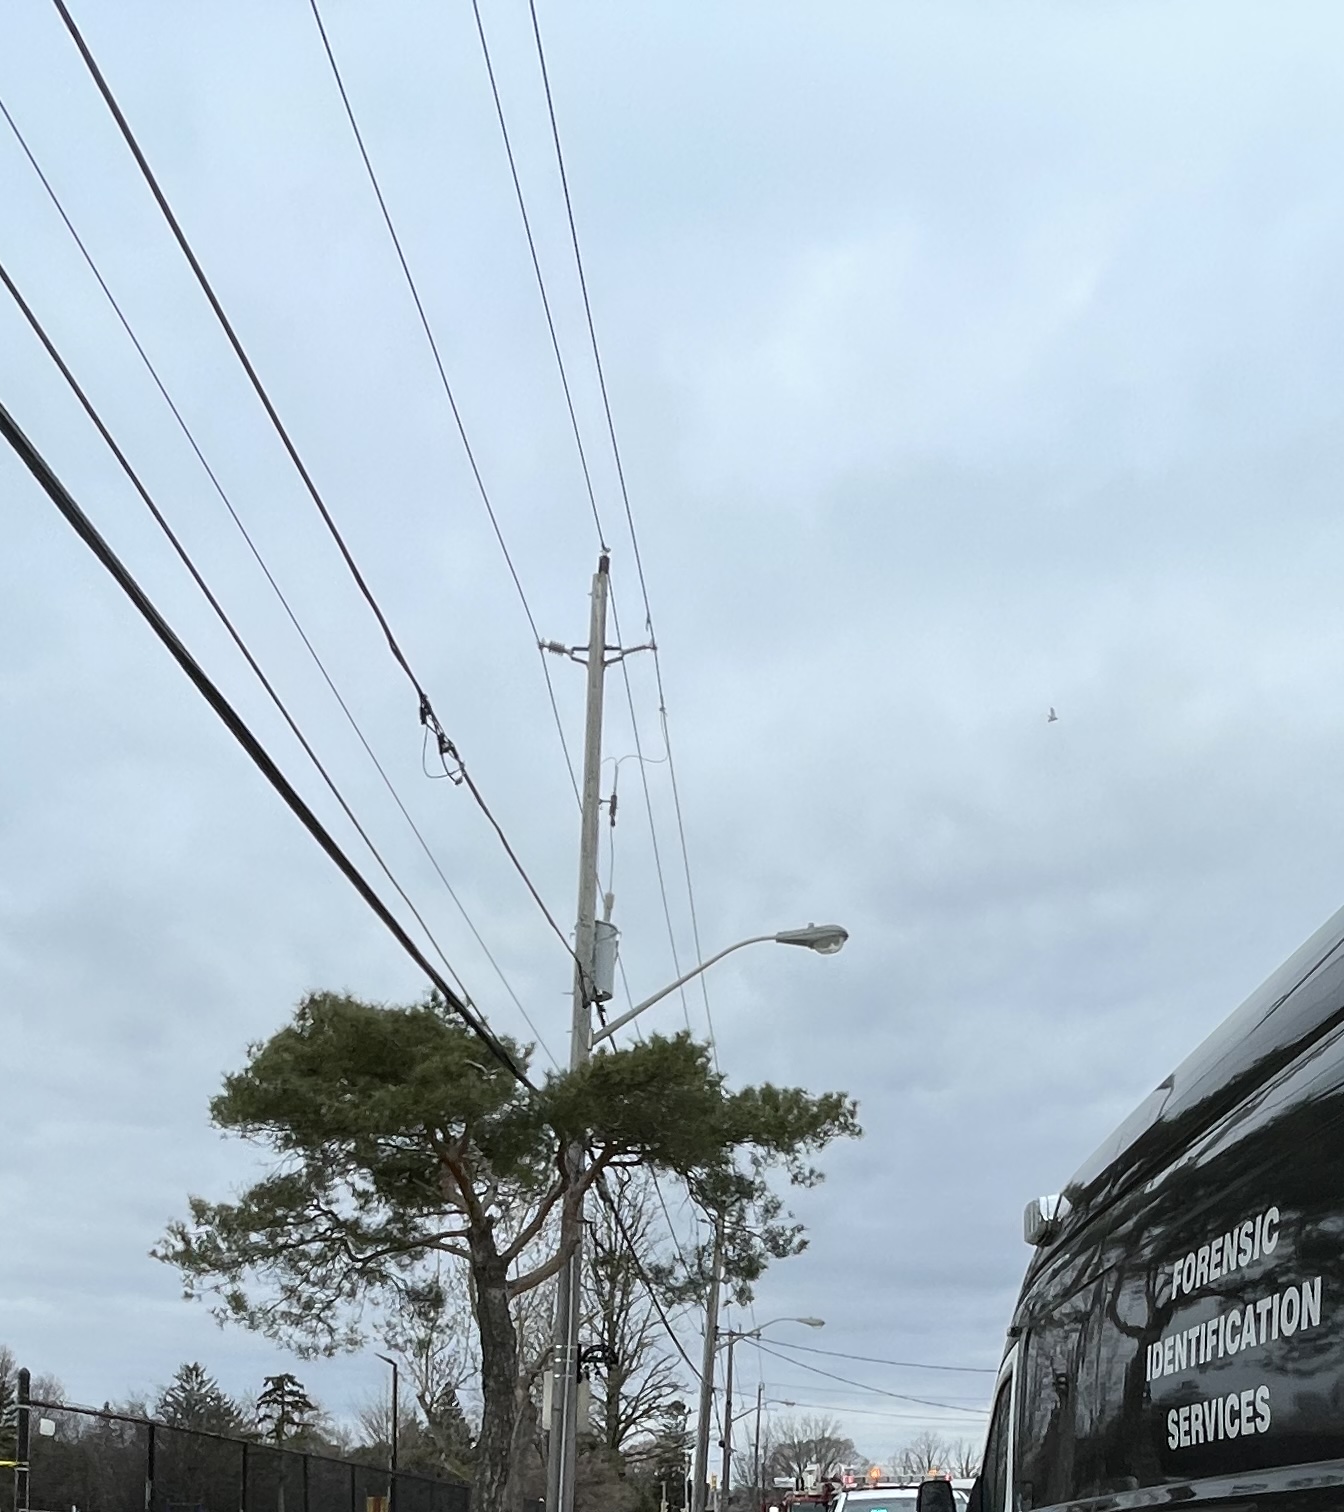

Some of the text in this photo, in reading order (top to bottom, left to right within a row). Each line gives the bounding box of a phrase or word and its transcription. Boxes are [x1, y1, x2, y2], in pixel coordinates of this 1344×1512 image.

[1171, 1206, 1280, 1300] FORENSIC
[1146, 1277, 1323, 1382] IDENTIFICATION
[1167, 1385, 1272, 1450] SERVICES
